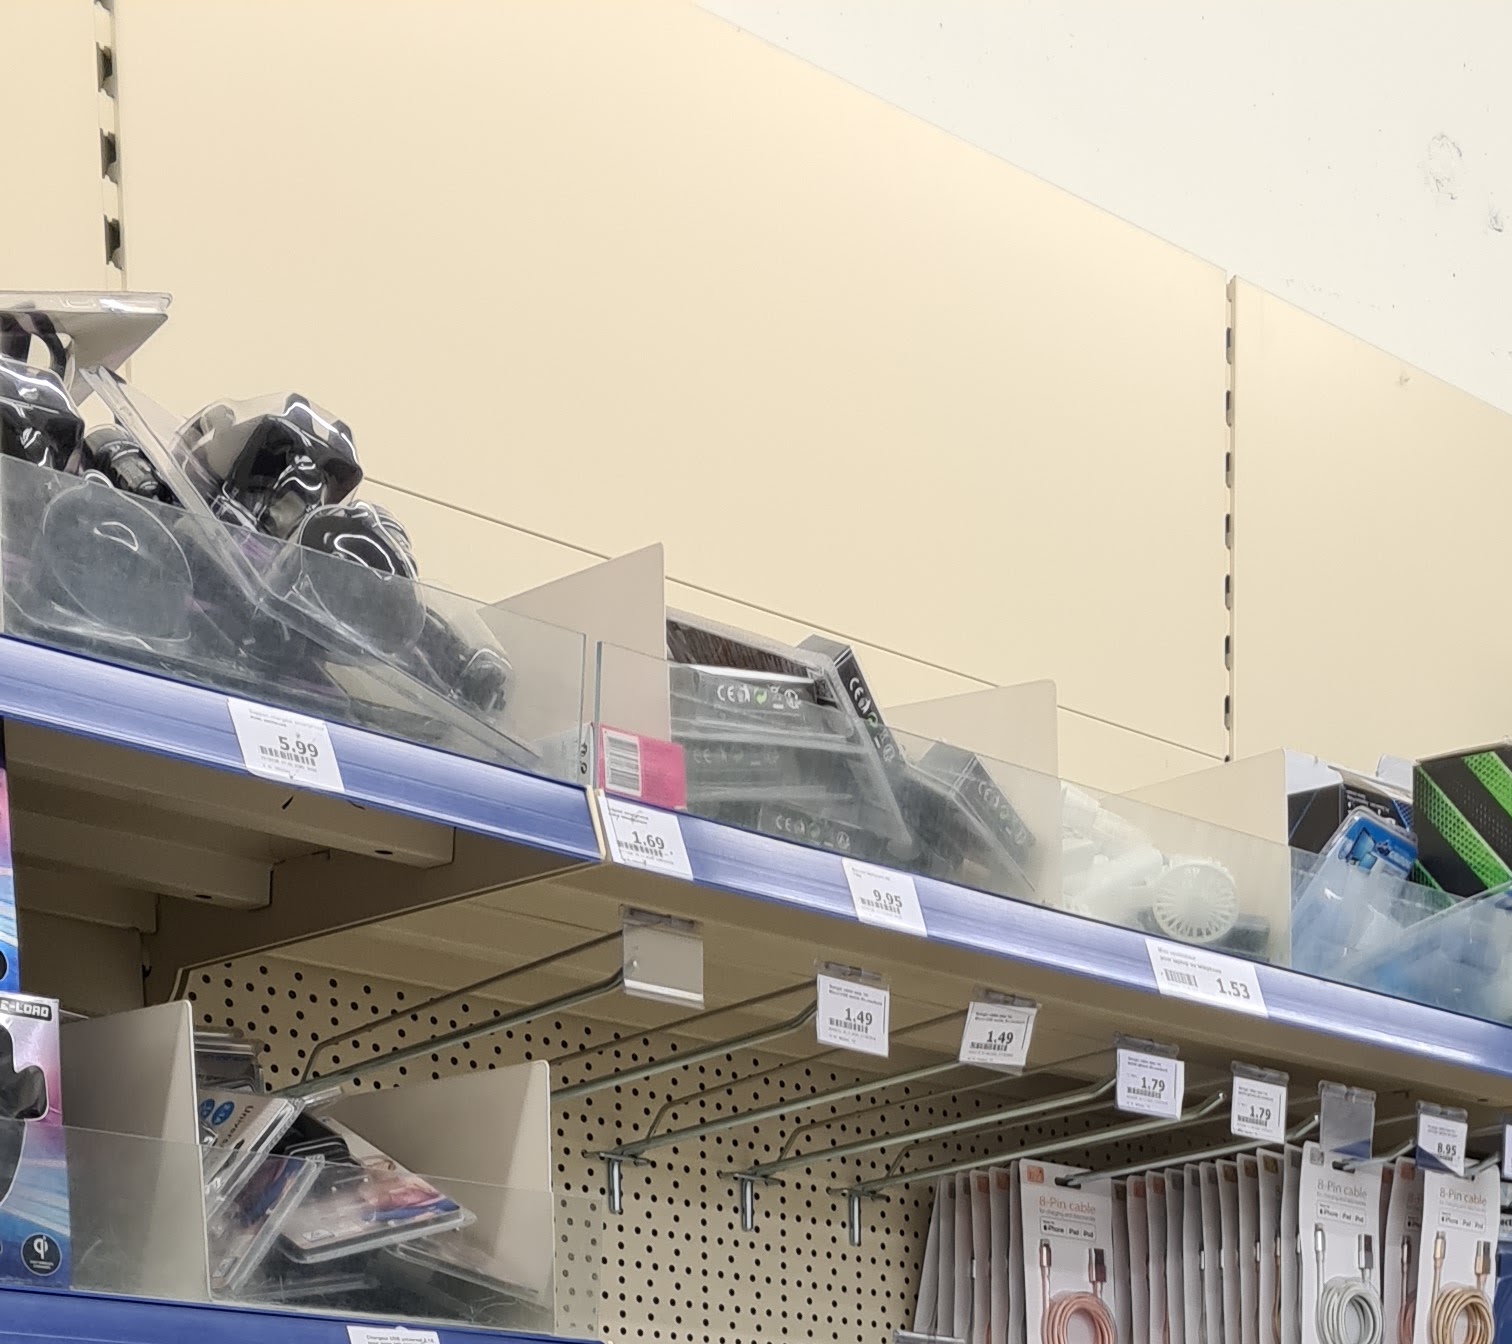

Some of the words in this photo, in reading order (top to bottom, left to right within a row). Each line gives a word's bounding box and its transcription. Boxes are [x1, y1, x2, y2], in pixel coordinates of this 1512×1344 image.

[278, 736, 319, 757] 5.99
[632, 830, 664, 850] 1.69
[873, 889, 903, 908] 9.95
[1216, 978, 1251, 1000] 1.53
[845, 1007, 873, 1026] 1.49
[987, 1031, 1014, 1044] 1.49
[1140, 1076, 1166, 1092] 1.79
[1250, 1106, 1272, 1121] 1.79
[1437, 1142, 1457, 1157] 8.95
[1317, 1178, 1342, 1195] 8-Pin
[1343, 1184, 1367, 1198] cable
[1440, 1187, 1462, 1202] 8-Pin
[1463, 1192, 1487, 1206] cable
[1039, 1195, 1068, 1210] 8-Pin
[1070, 1199, 1096, 1214] cable
